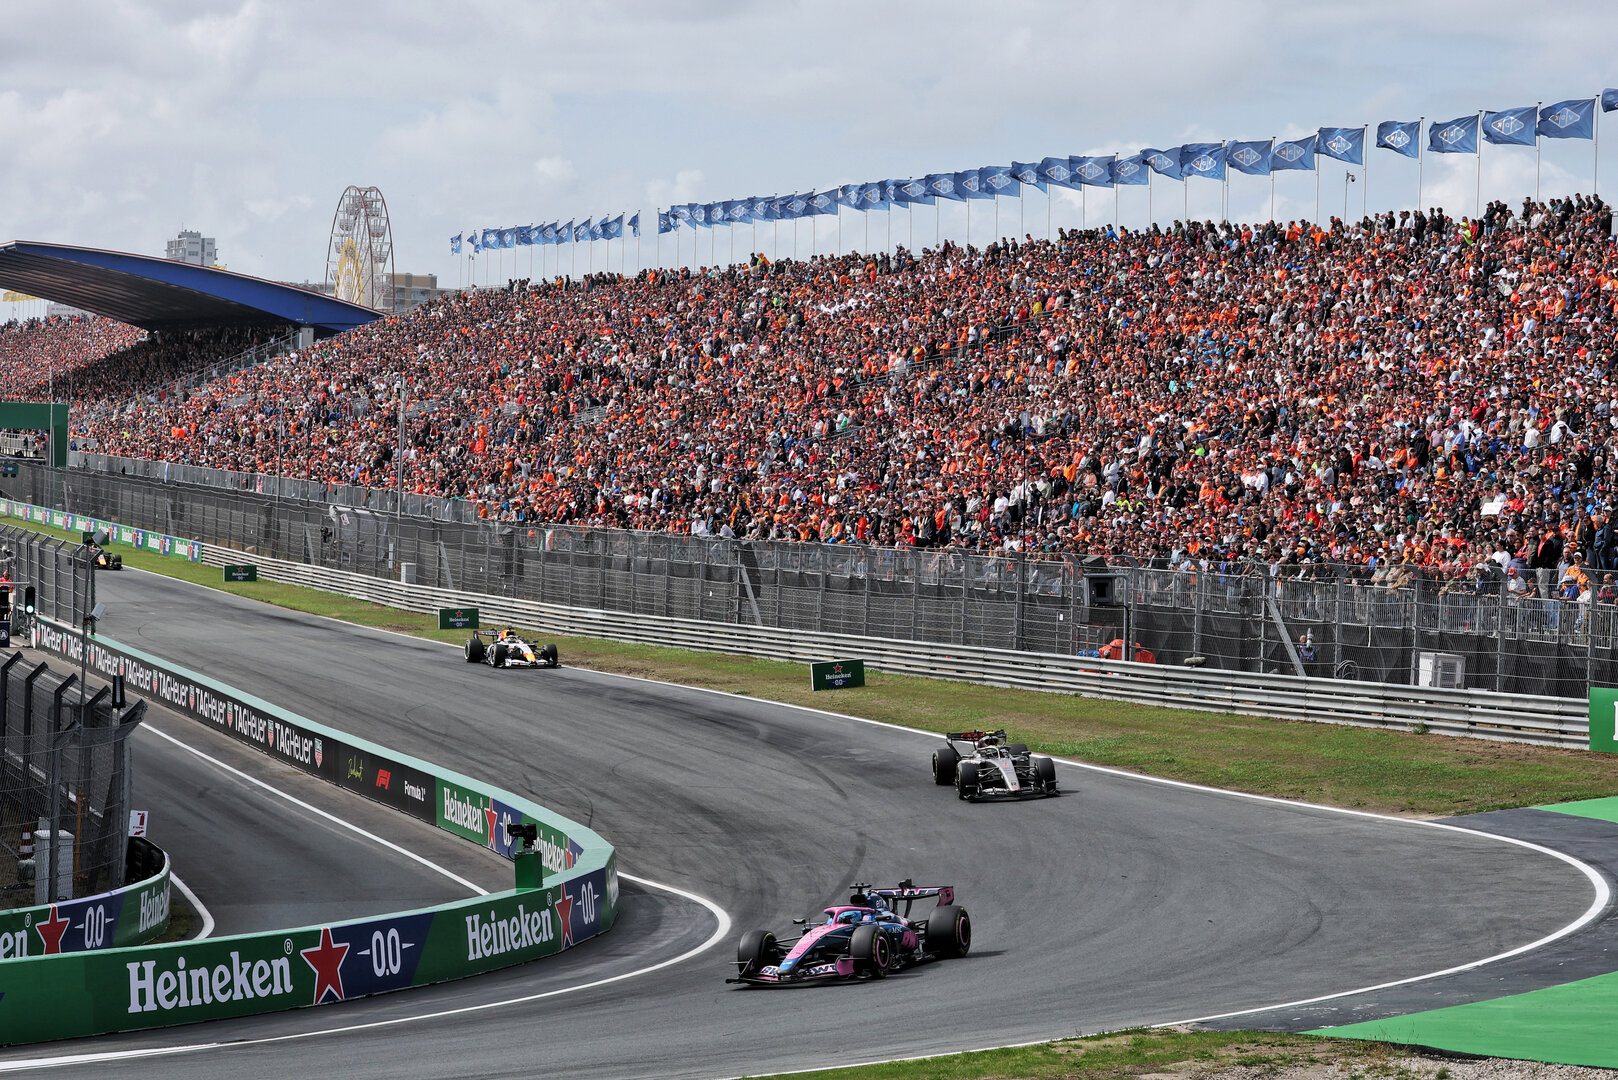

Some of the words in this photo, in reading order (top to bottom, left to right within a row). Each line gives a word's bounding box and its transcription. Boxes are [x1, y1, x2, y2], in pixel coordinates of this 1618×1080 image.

[443, 787, 483, 834] Heineken
[532, 829, 566, 873] eineken
[126, 950, 294, 1014] Heineken
[371, 927, 401, 978] 0.0
[465, 904, 554, 961] Heineken
